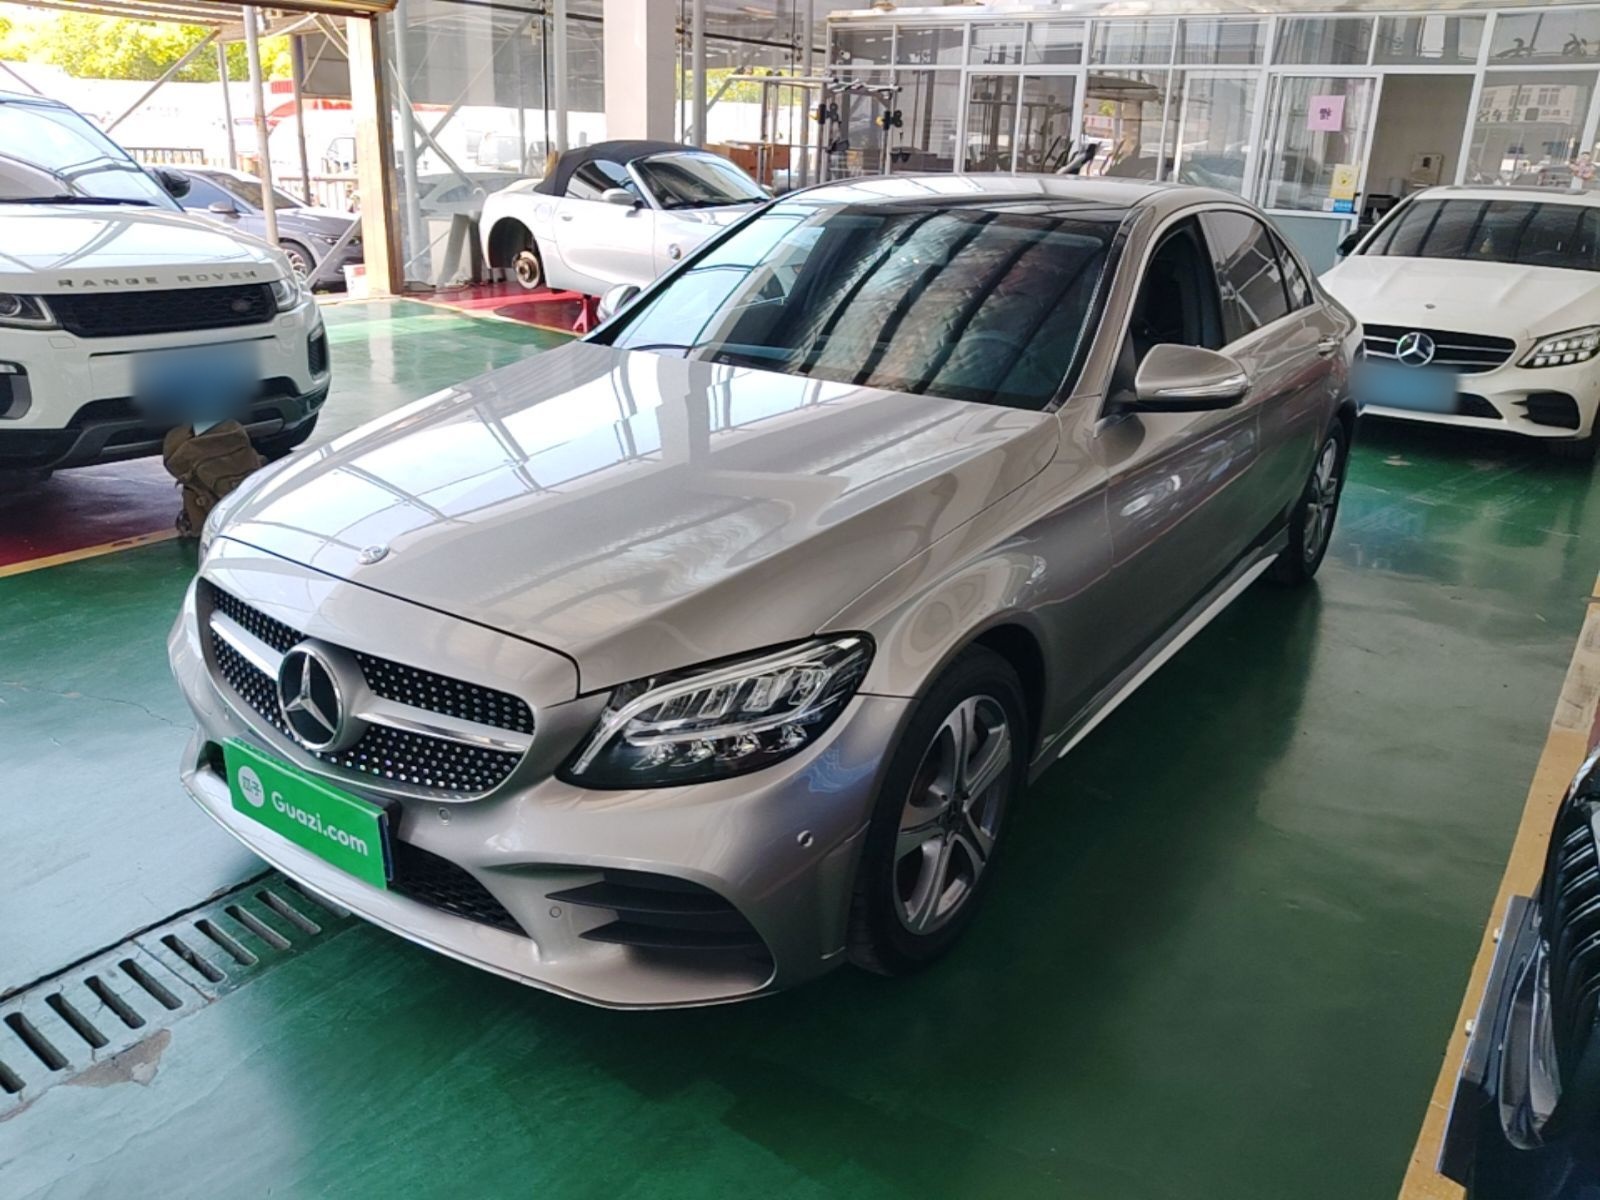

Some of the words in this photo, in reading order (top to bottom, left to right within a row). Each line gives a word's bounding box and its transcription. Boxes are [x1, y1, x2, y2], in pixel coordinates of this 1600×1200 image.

[58, 277, 159, 288] RANGE
[177, 270, 258, 283] ROVER
[271, 791, 368, 857] Guazi.com
